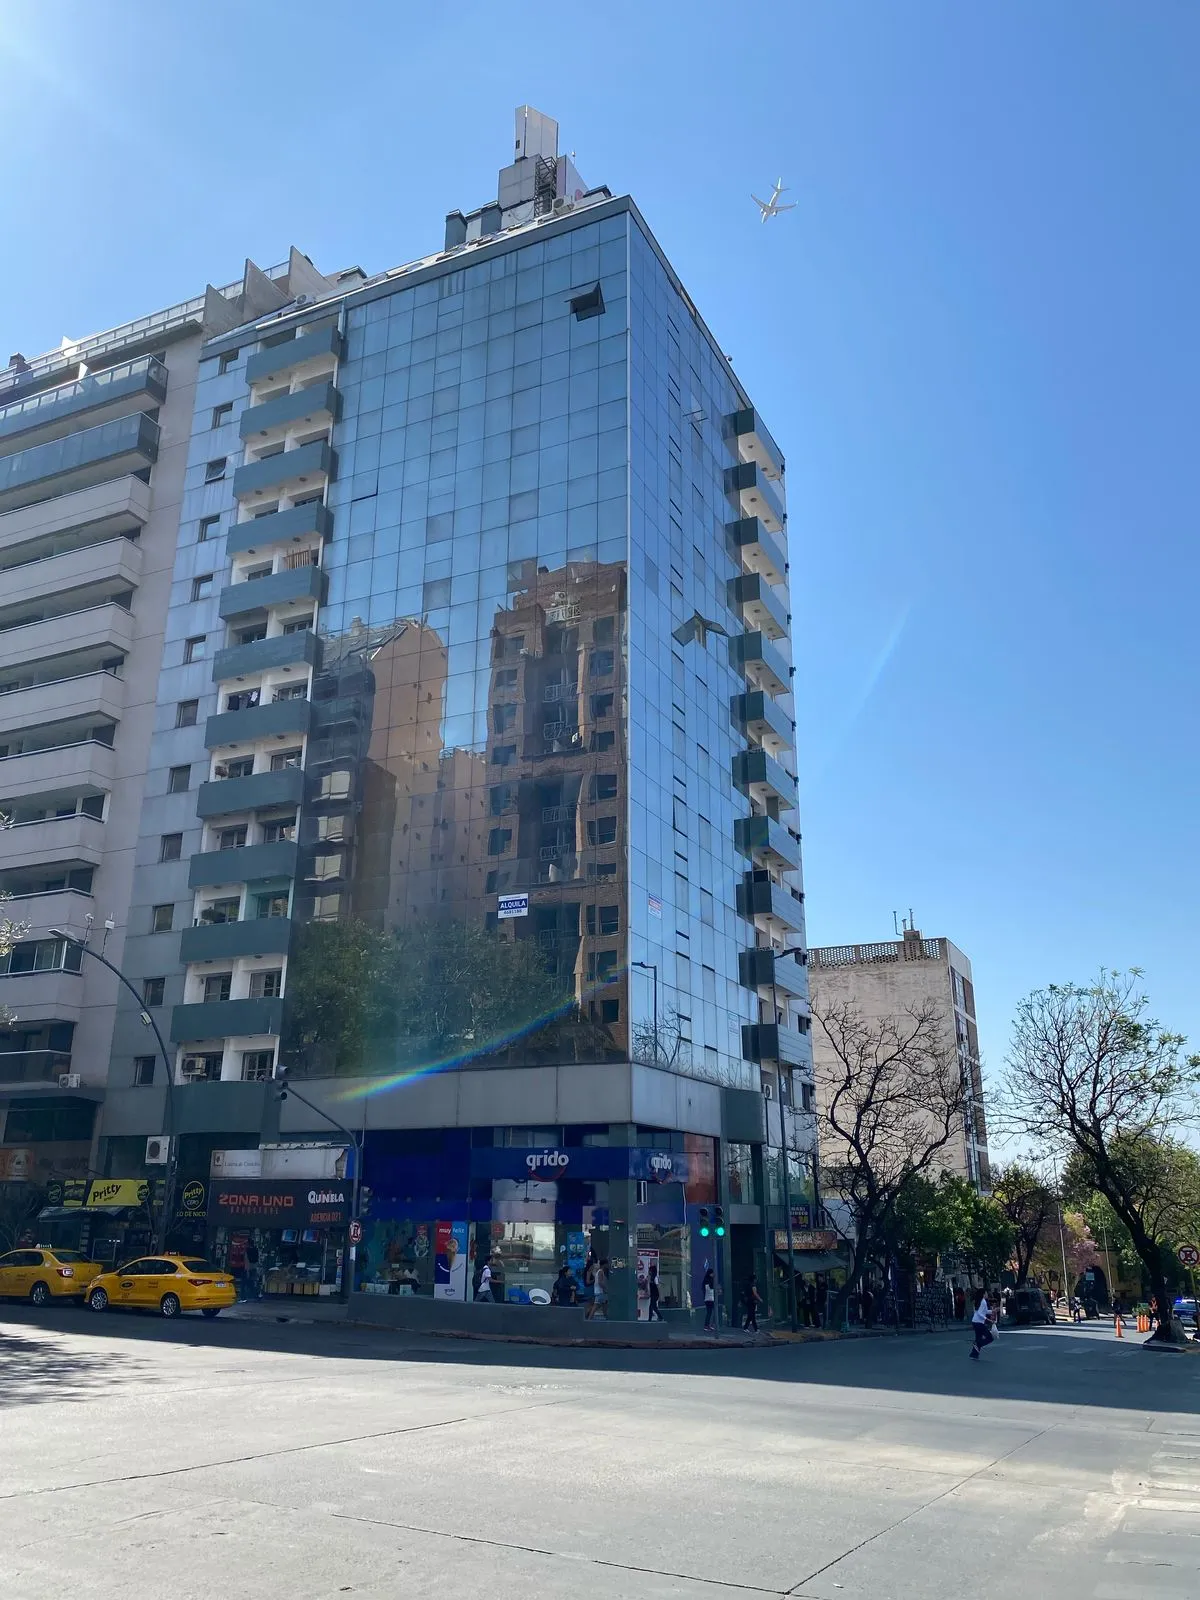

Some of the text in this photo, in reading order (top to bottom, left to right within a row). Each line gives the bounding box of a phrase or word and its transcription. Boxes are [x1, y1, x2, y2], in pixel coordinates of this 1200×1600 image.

[500, 900, 526, 909] ALQUILA
[526, 1150, 569, 1170] grido
[92, 1184, 121, 1202] Pritty
[184, 1187, 203, 1199] Pritty
[218, 1193, 294, 1207] ZONA UNO
